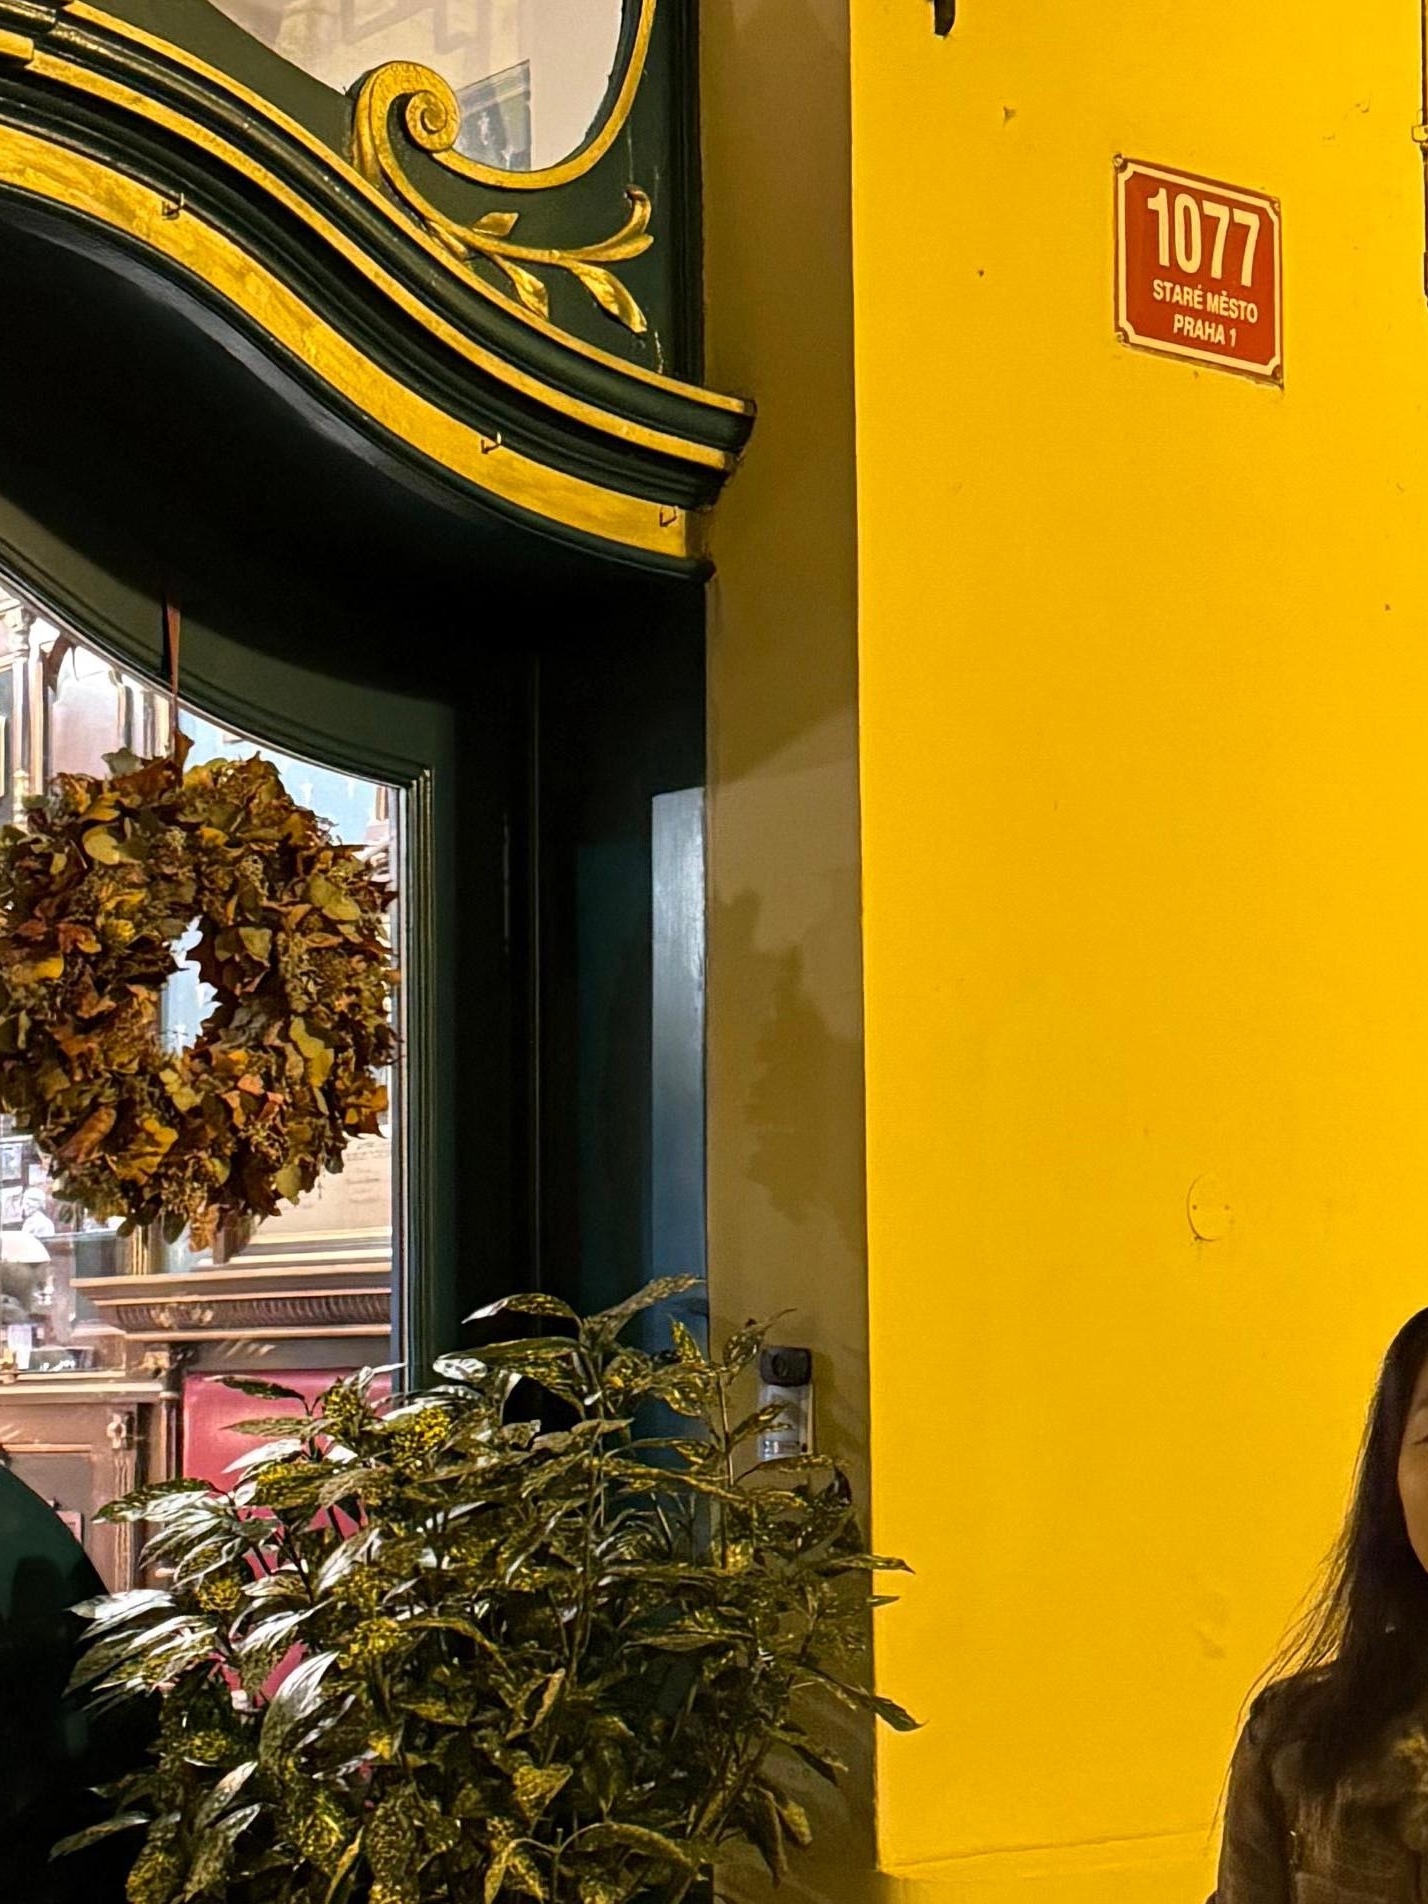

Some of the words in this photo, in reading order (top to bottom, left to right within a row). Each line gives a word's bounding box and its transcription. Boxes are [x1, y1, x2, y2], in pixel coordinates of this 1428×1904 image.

[1147, 187, 1261, 288] 1077
[1153, 278, 1204, 310] STARÉ
[1207, 290, 1259, 324] MĚSTO
[1173, 313, 1226, 345] PRAHA
[1229, 327, 1237, 347] 1
